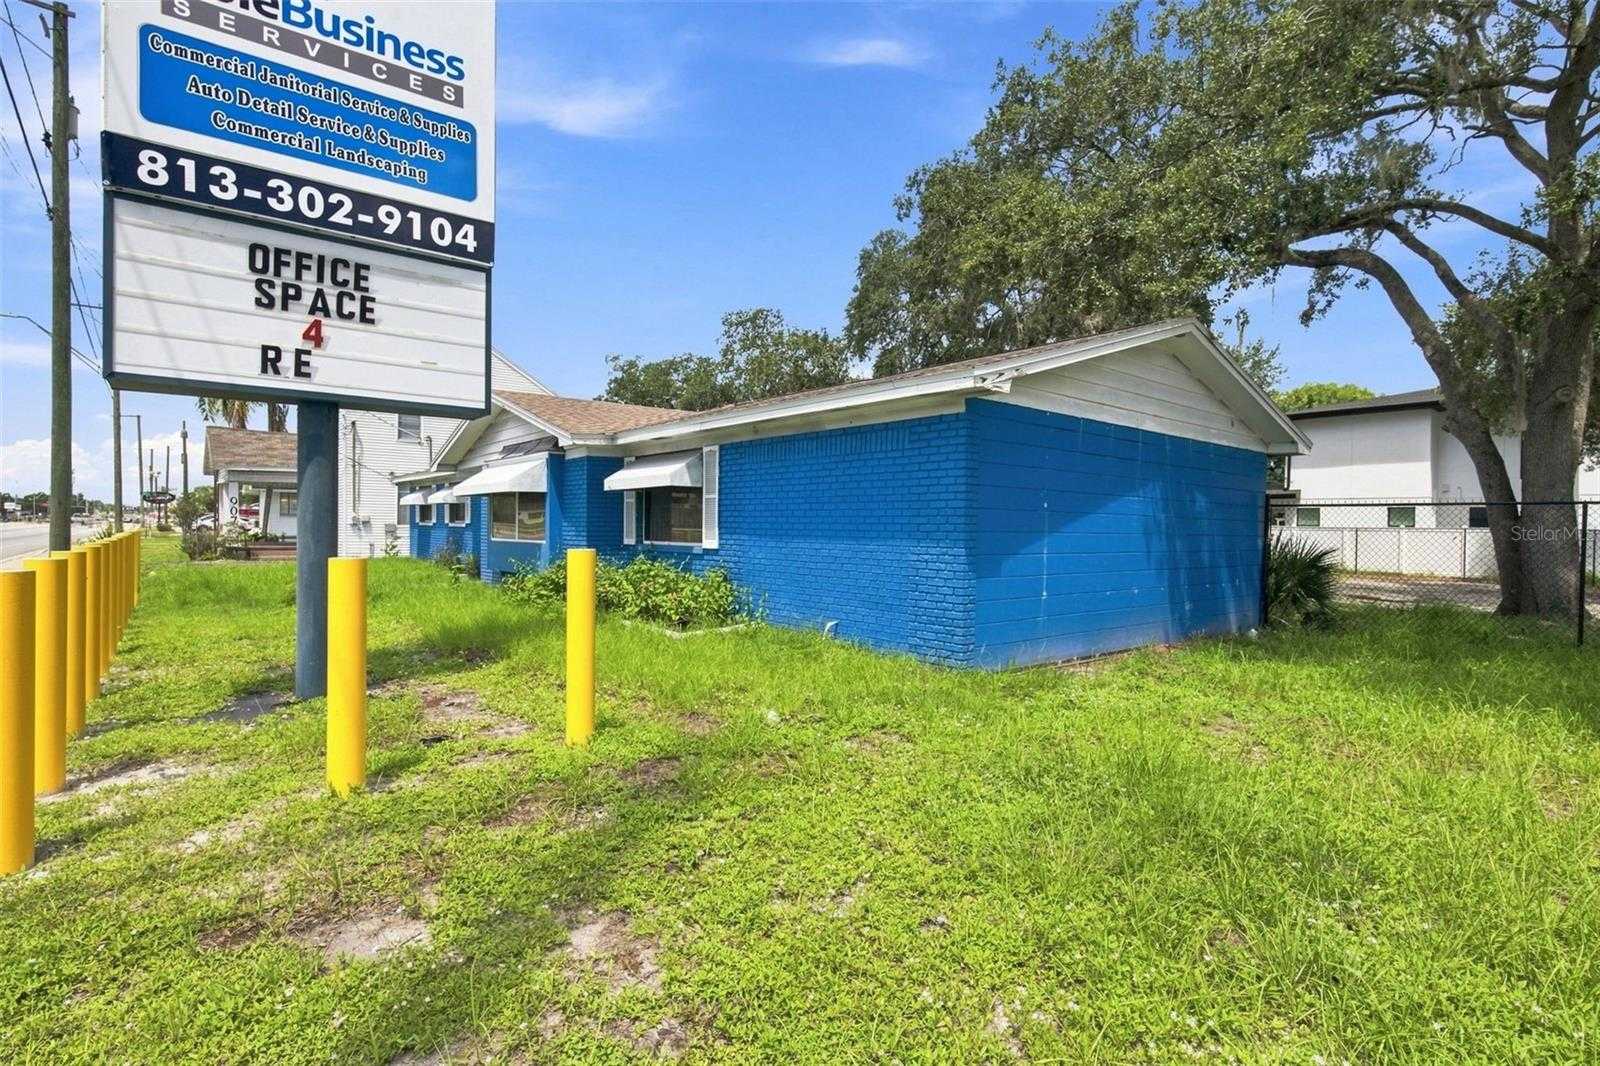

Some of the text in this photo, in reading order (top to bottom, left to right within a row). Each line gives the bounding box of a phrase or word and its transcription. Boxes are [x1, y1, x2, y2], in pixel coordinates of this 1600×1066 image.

[149, 33, 471, 142] Commercial Janitorial Service & Supplies
[173, 0, 456, 101] SERVICES
[187, 75, 445, 162] Auto Detail Service & Supplies
[211, 111, 427, 184] Commercial Landscaping
[136, 149, 477, 253] 813-302-9104
[248, 243, 371, 294] OFFICE
[254, 278, 376, 324] SPACE
[302, 318, 325, 348] 4
